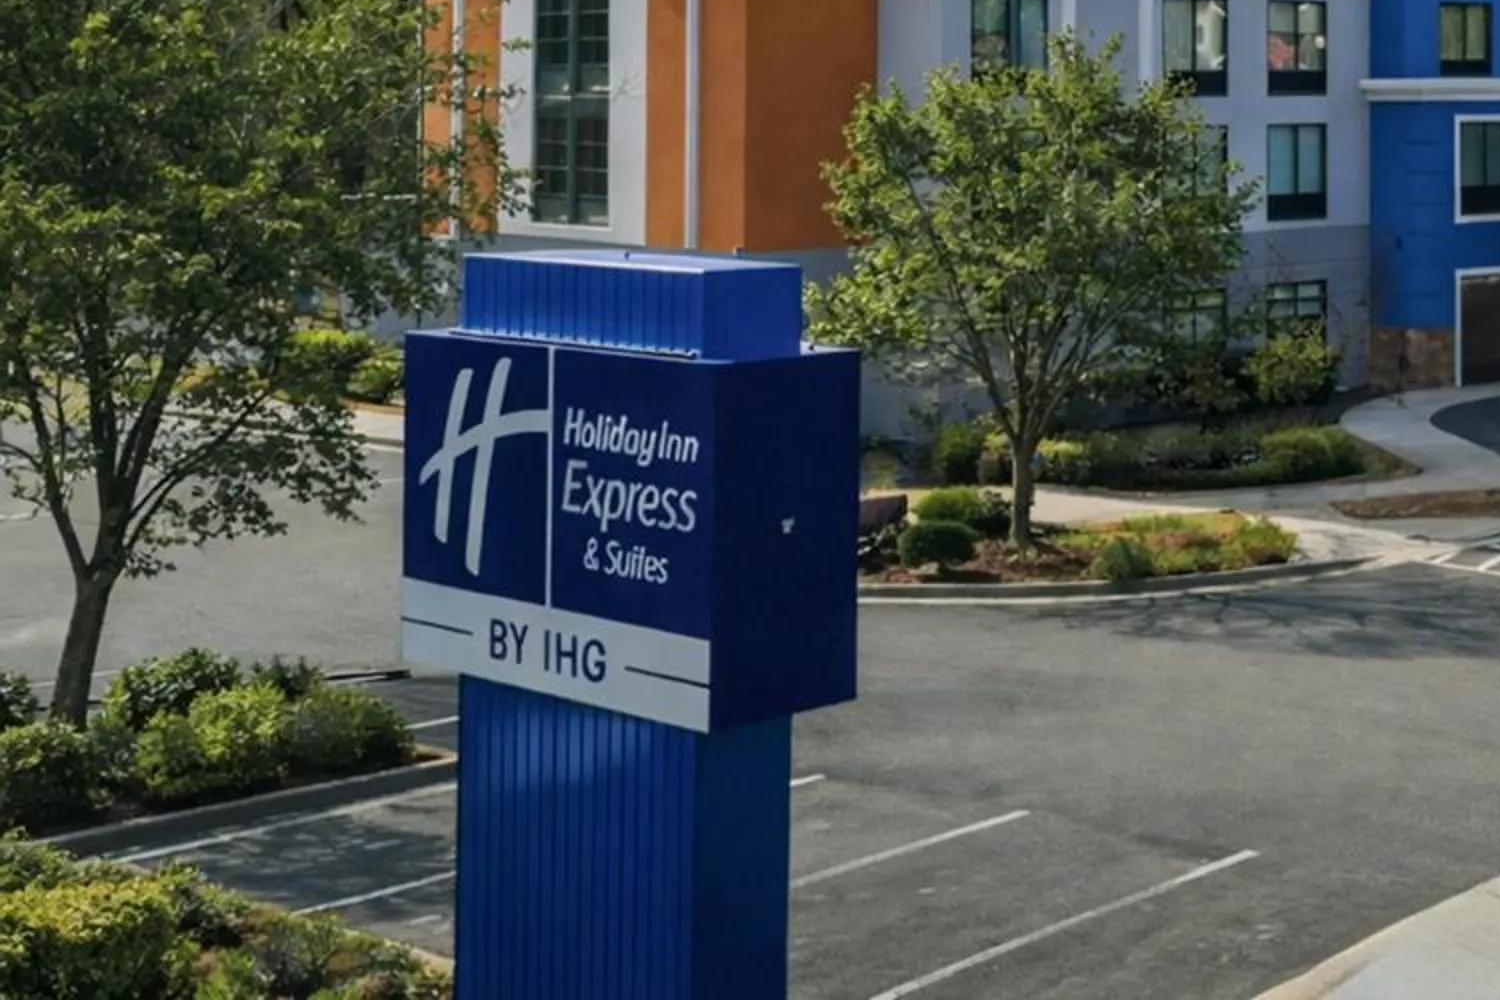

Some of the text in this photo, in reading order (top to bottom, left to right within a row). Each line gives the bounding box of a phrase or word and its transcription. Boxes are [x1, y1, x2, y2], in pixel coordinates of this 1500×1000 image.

[563, 406, 700, 467] Holiday Inn
[561, 458, 698, 533] Express
[583, 536, 669, 584] & Suites
[489, 618, 607, 683] BY IHG
